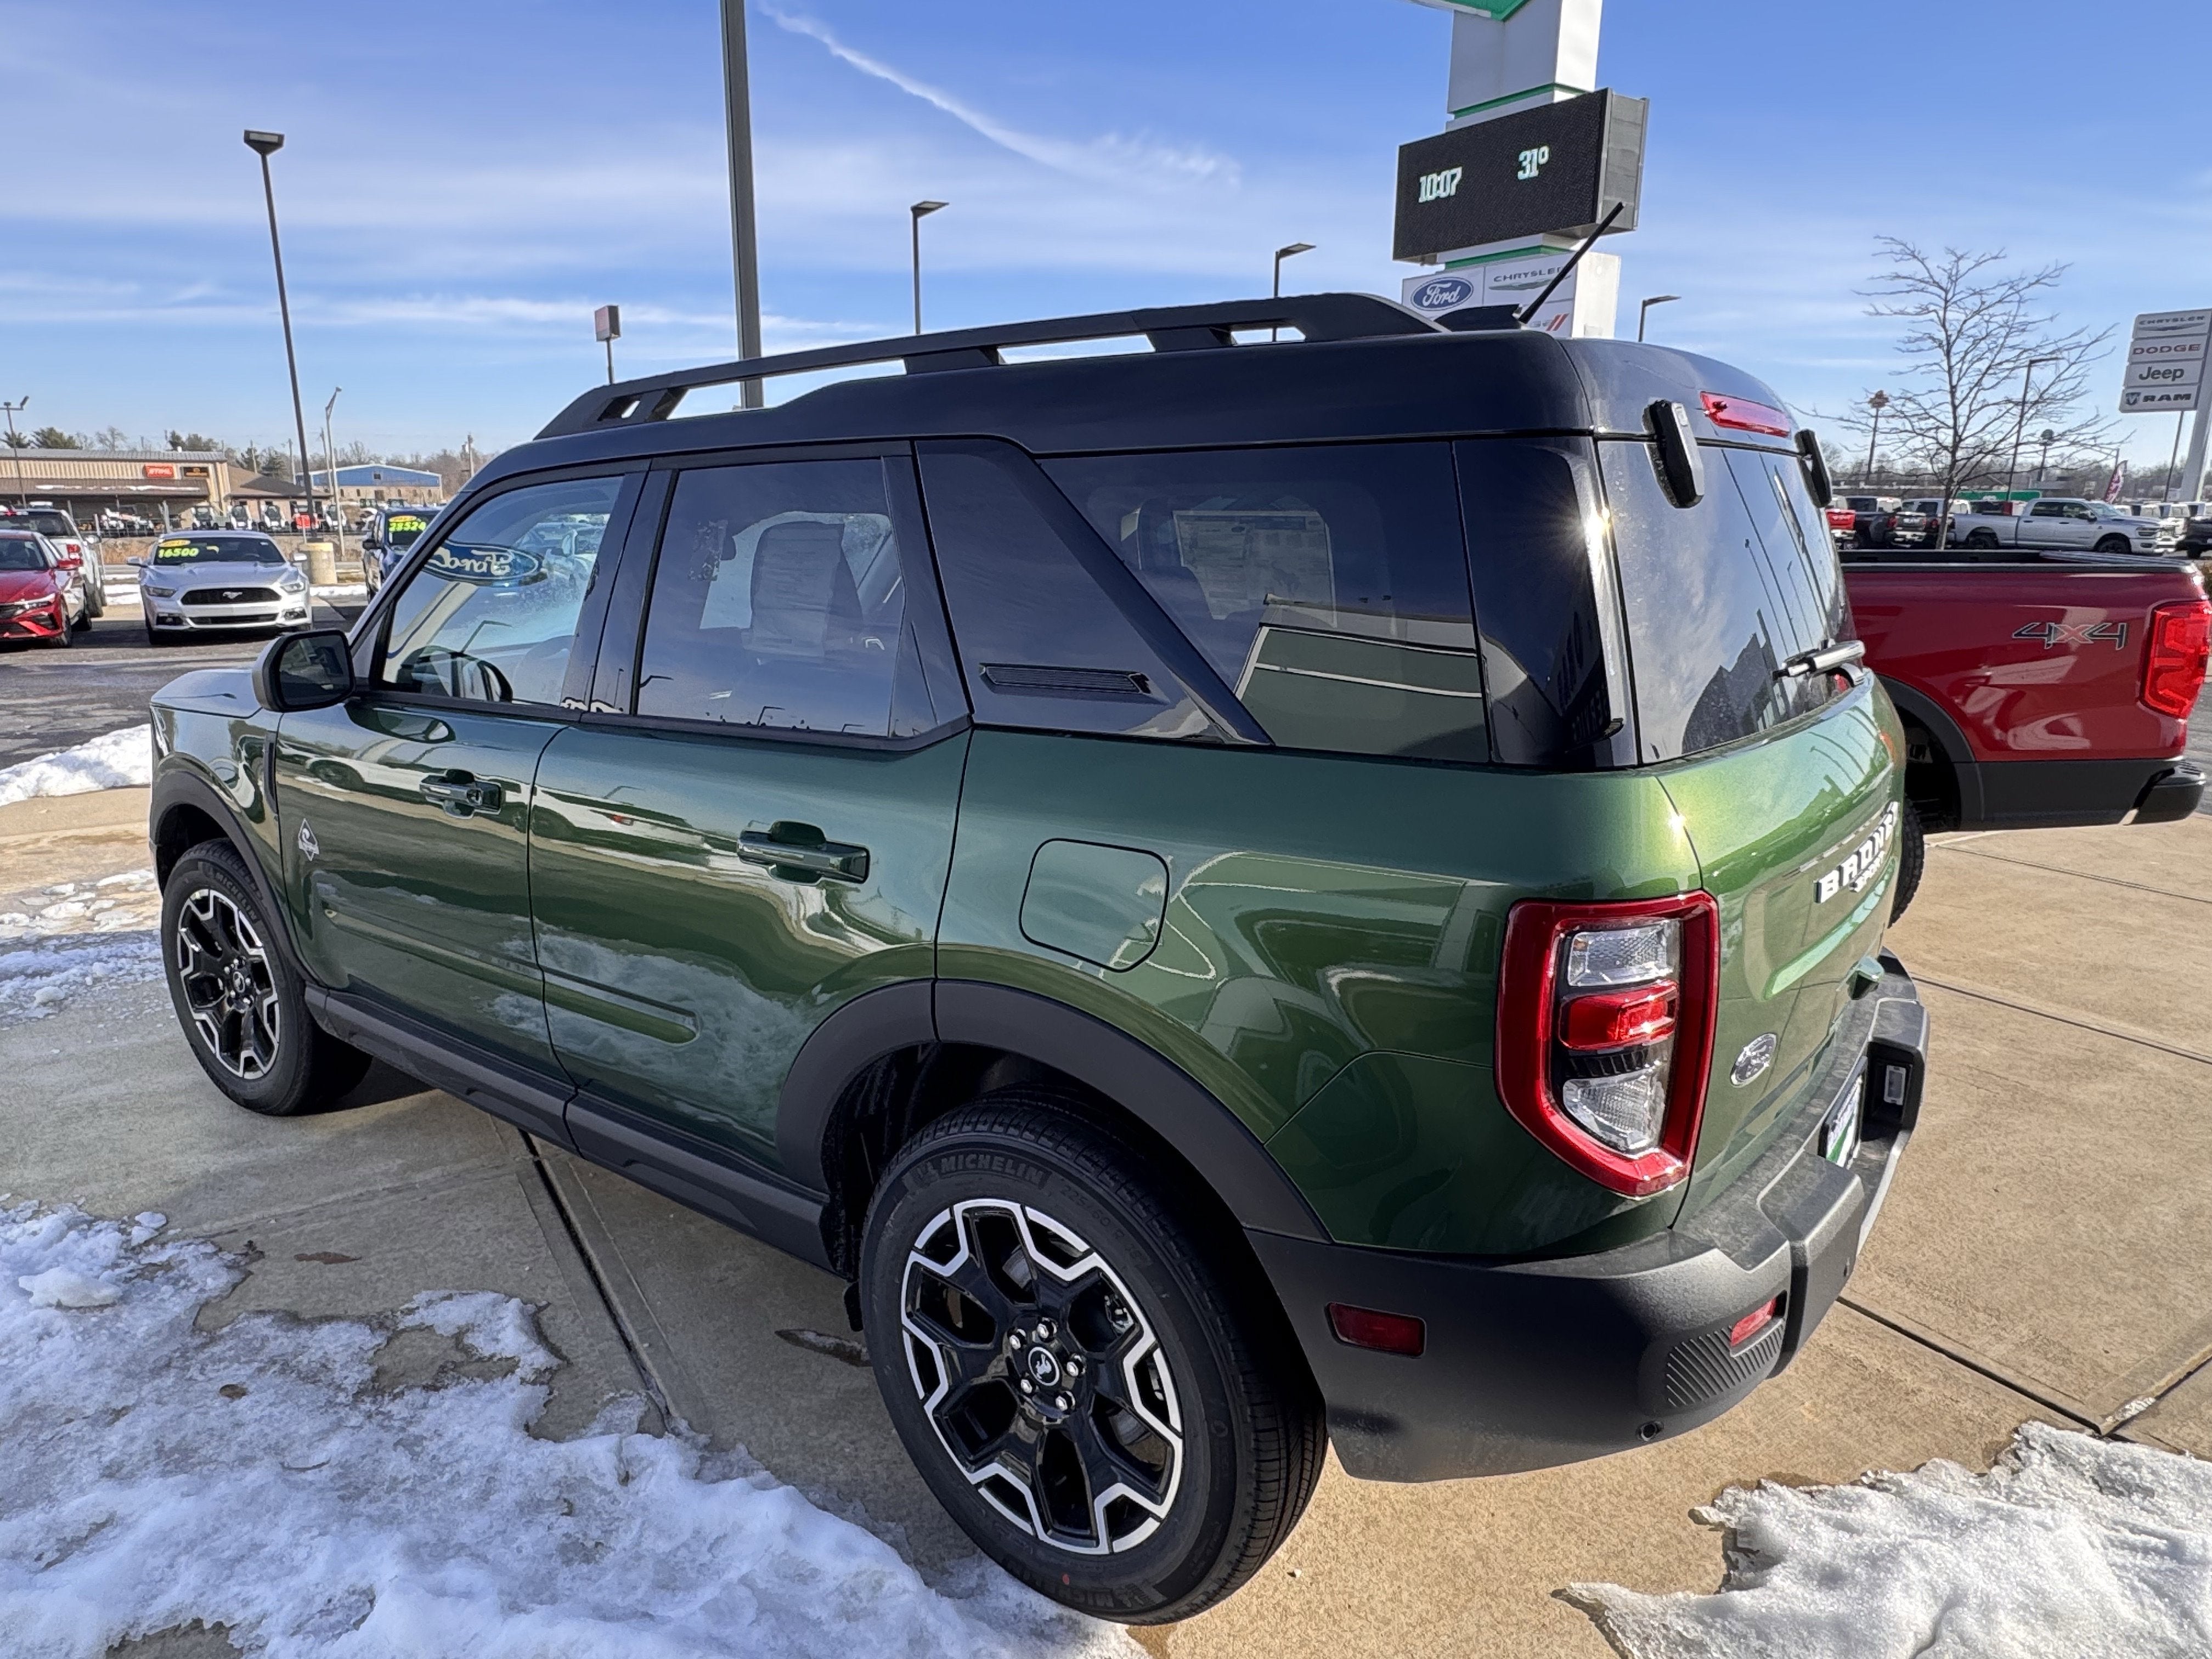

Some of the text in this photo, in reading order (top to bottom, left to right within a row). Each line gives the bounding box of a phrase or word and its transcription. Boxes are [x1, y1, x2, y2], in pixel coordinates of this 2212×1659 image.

[1419, 166, 1463, 203] 10:07
[1422, 282, 1460, 306] Ford
[2139, 316, 2204, 325] CHRYSLER
[2133, 343, 2201, 355] DODGE
[2138, 366, 2185, 381] Jeep
[2142, 393, 2191, 402] RAM
[940, 1154, 1043, 1185] MICHELIN
